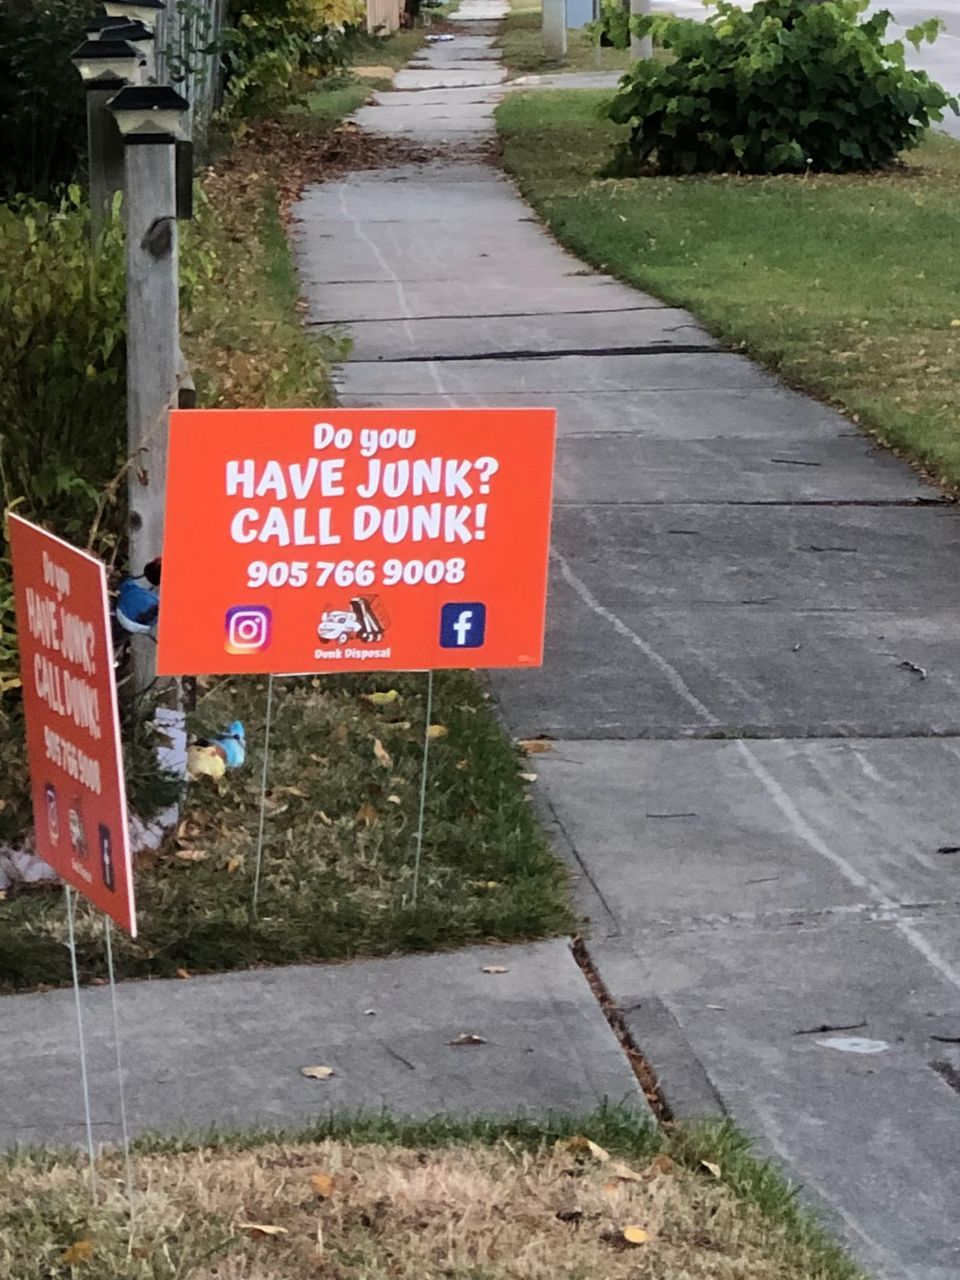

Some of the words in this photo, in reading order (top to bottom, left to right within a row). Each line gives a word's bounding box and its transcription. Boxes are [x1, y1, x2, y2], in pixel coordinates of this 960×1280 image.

[313, 423, 353, 450] Do
[359, 428, 417, 457] you
[226, 457, 346, 501] HAVE
[356, 456, 499, 499] JUNK?
[230, 506, 341, 547] CALL
[353, 503, 488, 545] DUNK!
[246, 560, 309, 588] 905
[315, 559, 377, 587] 766
[382, 557, 466, 586] 9008
[26, 587, 59, 651] HAVE
[61, 606, 96, 677] JUNK?
[314, 648, 342, 659] Dunk
[34, 652, 65, 715] CALL
[64, 670, 101, 740] DUNK!
